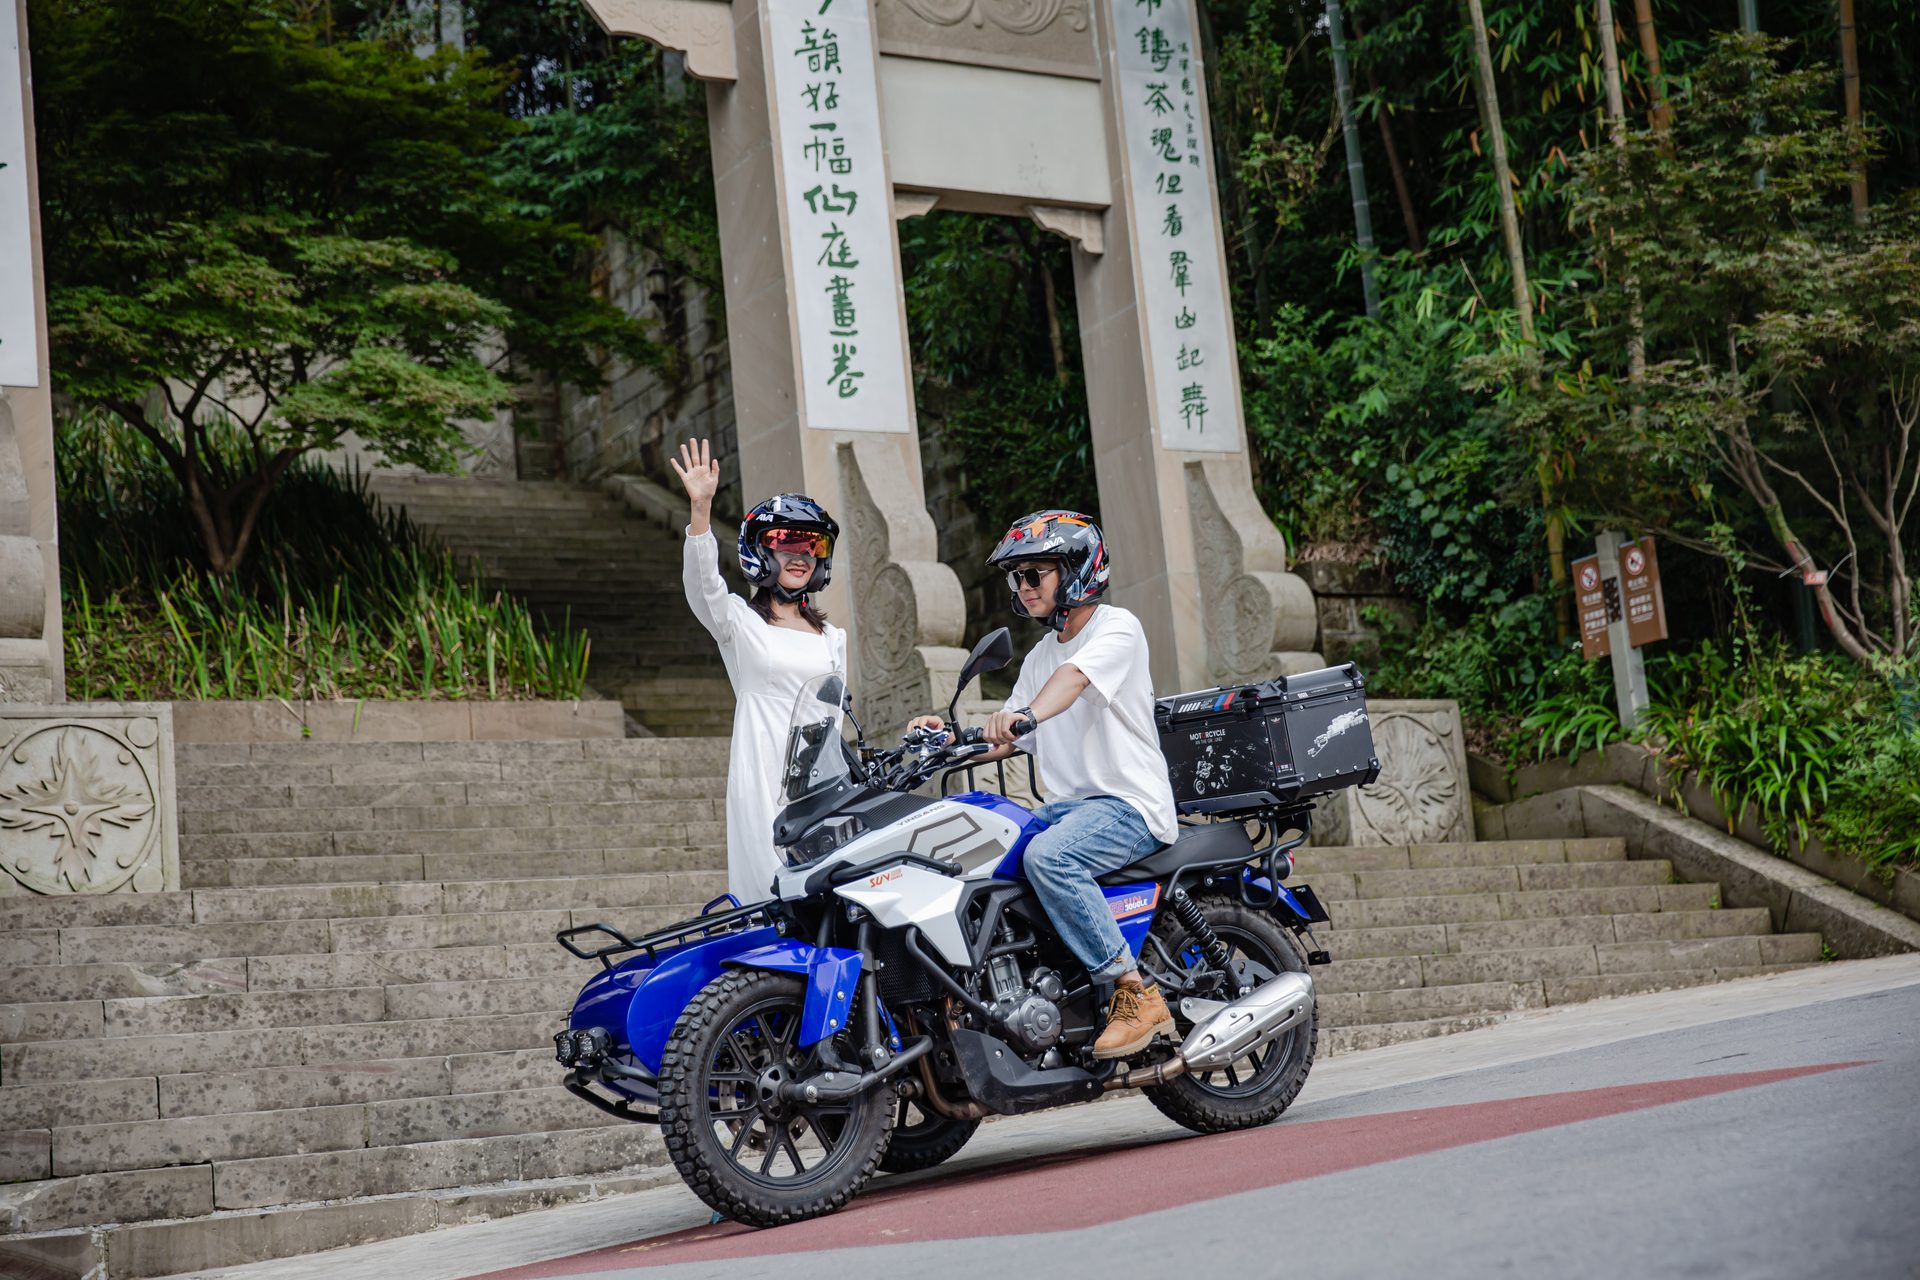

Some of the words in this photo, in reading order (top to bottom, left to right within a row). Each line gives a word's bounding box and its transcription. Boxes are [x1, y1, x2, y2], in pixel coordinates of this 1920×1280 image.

[795, 0, 864, 398] 韻好一幅仙庭畫卷
[756, 513, 774, 522] AVA
[1042, 536, 1065, 551] AVA
[1189, 728, 1226, 741] MOTORCYCLE
[896, 804, 945, 826] YINGANG
